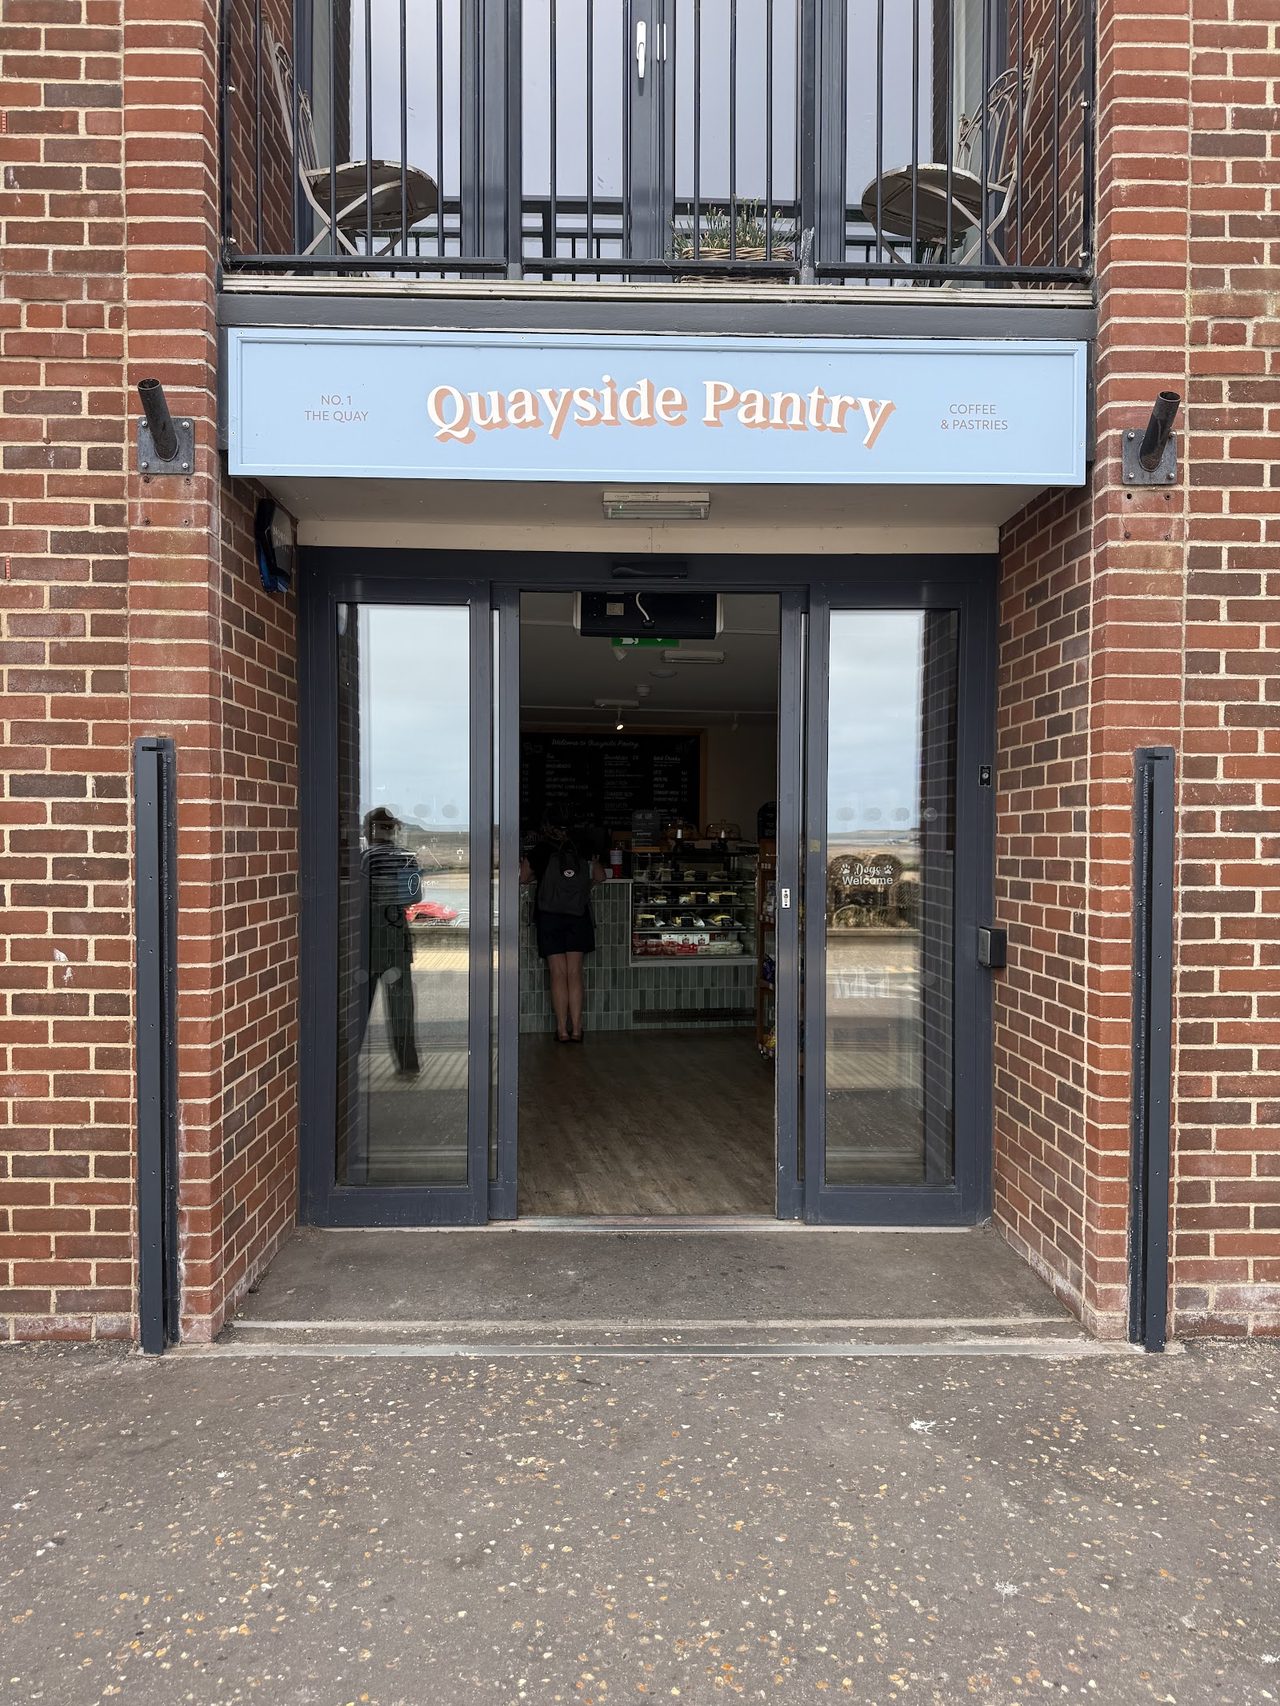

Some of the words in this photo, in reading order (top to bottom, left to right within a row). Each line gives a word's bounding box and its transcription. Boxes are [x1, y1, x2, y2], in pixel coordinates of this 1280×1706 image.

[427, 374, 688, 445] Quayside
[702, 380, 897, 450] Pantry
[949, 403, 997, 415] COFFEE
[304, 410, 330, 421] THE
[333, 410, 369, 424] QUAY
[940, 419, 949, 430] &
[952, 419, 1009, 431] PASTRIES
[853, 862, 881, 878] Dogs
[842, 875, 893, 886] Welcome
